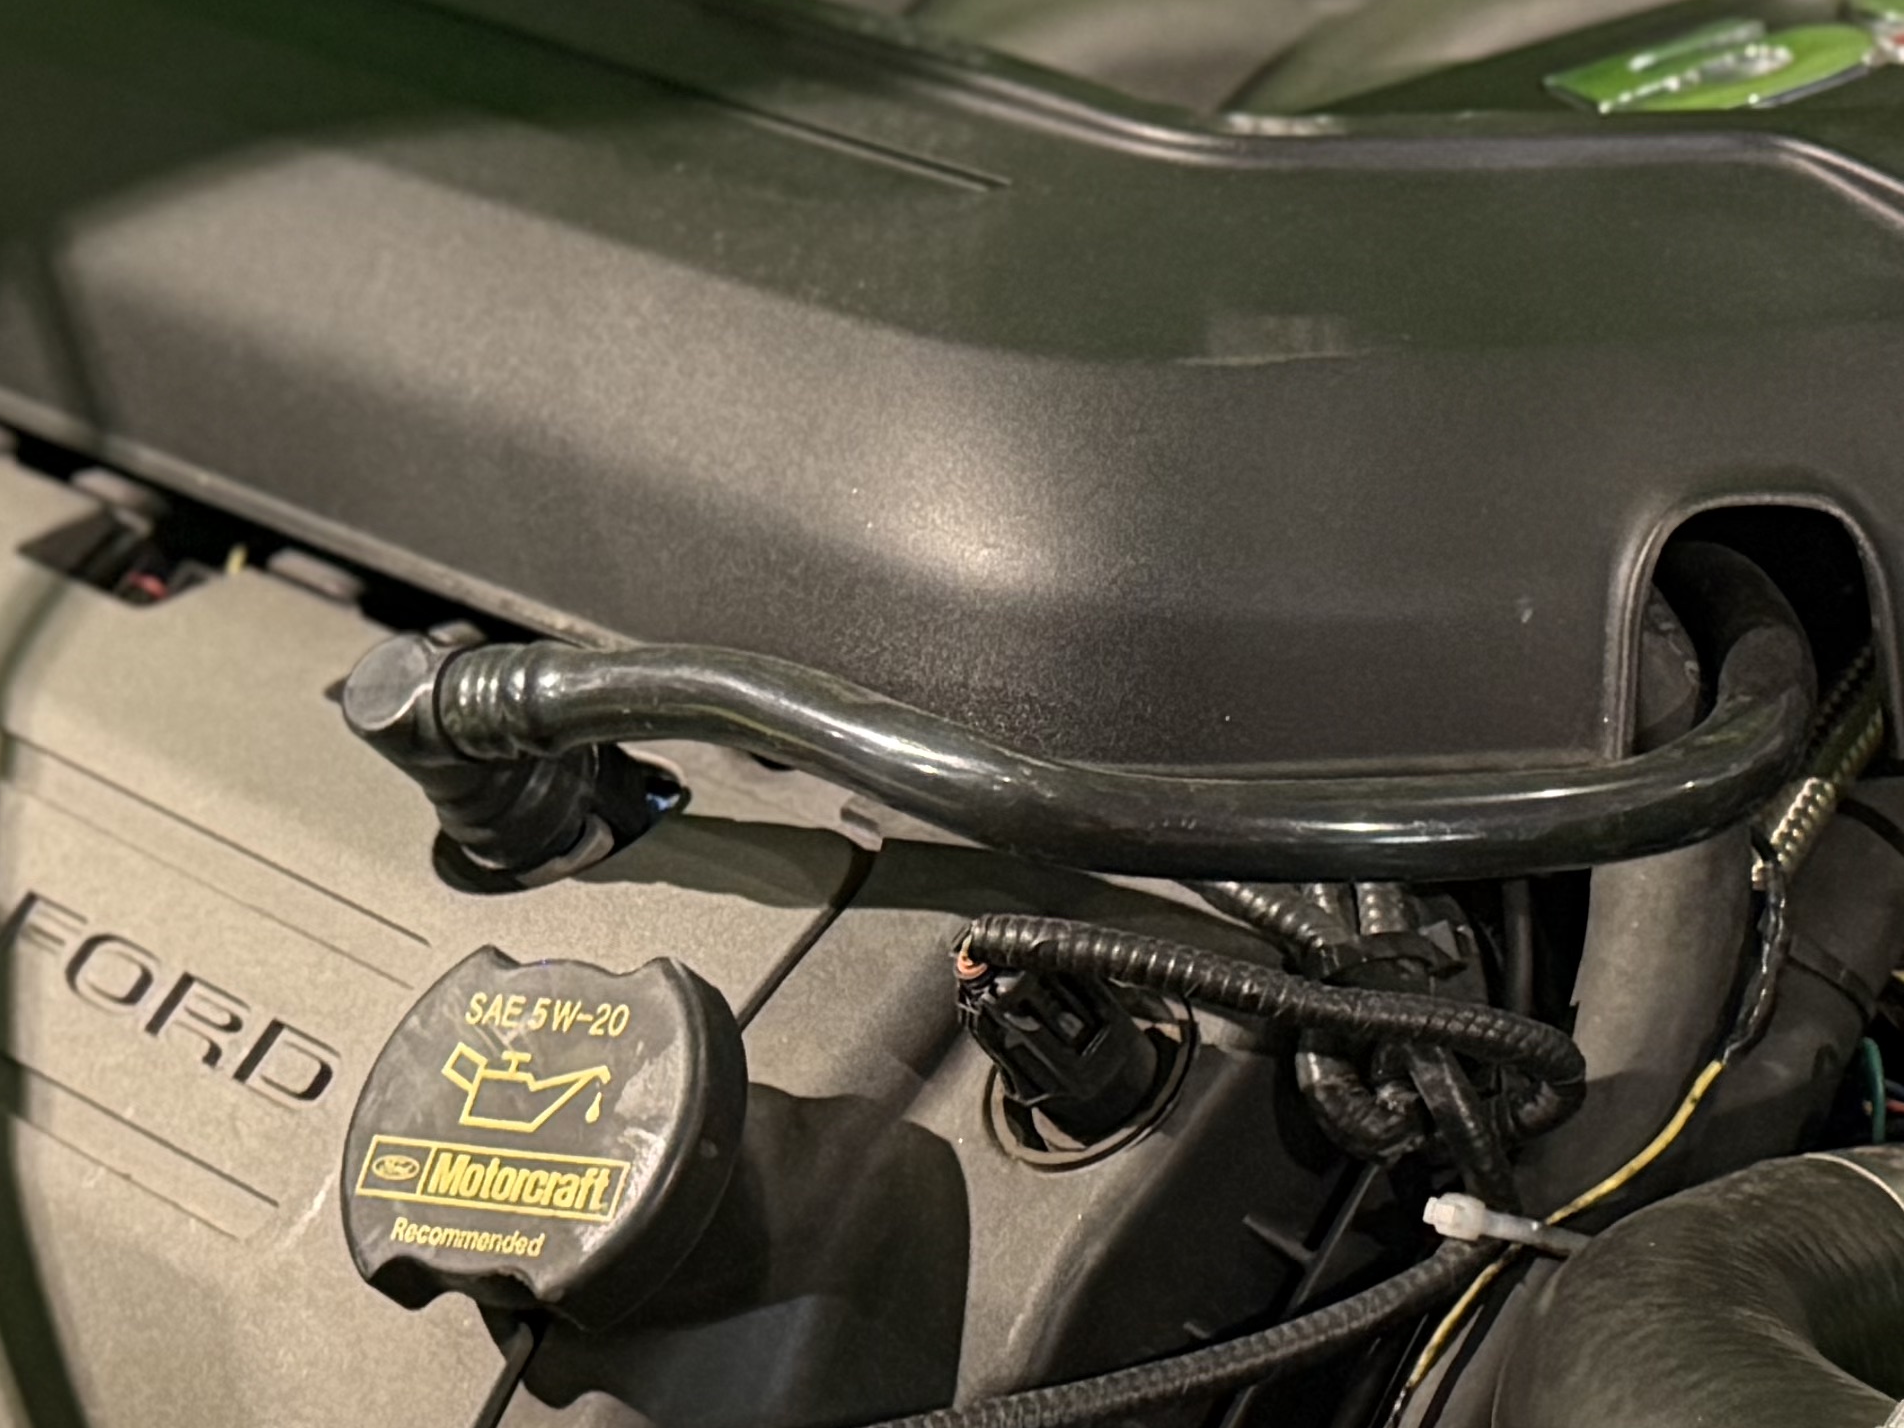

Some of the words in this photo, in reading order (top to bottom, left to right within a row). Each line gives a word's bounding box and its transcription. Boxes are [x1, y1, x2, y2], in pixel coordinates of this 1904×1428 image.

[465, 992, 526, 1029] SAE
[430, 1152, 610, 1211] Motorcraft
[392, 1218, 545, 1257] Recommended
